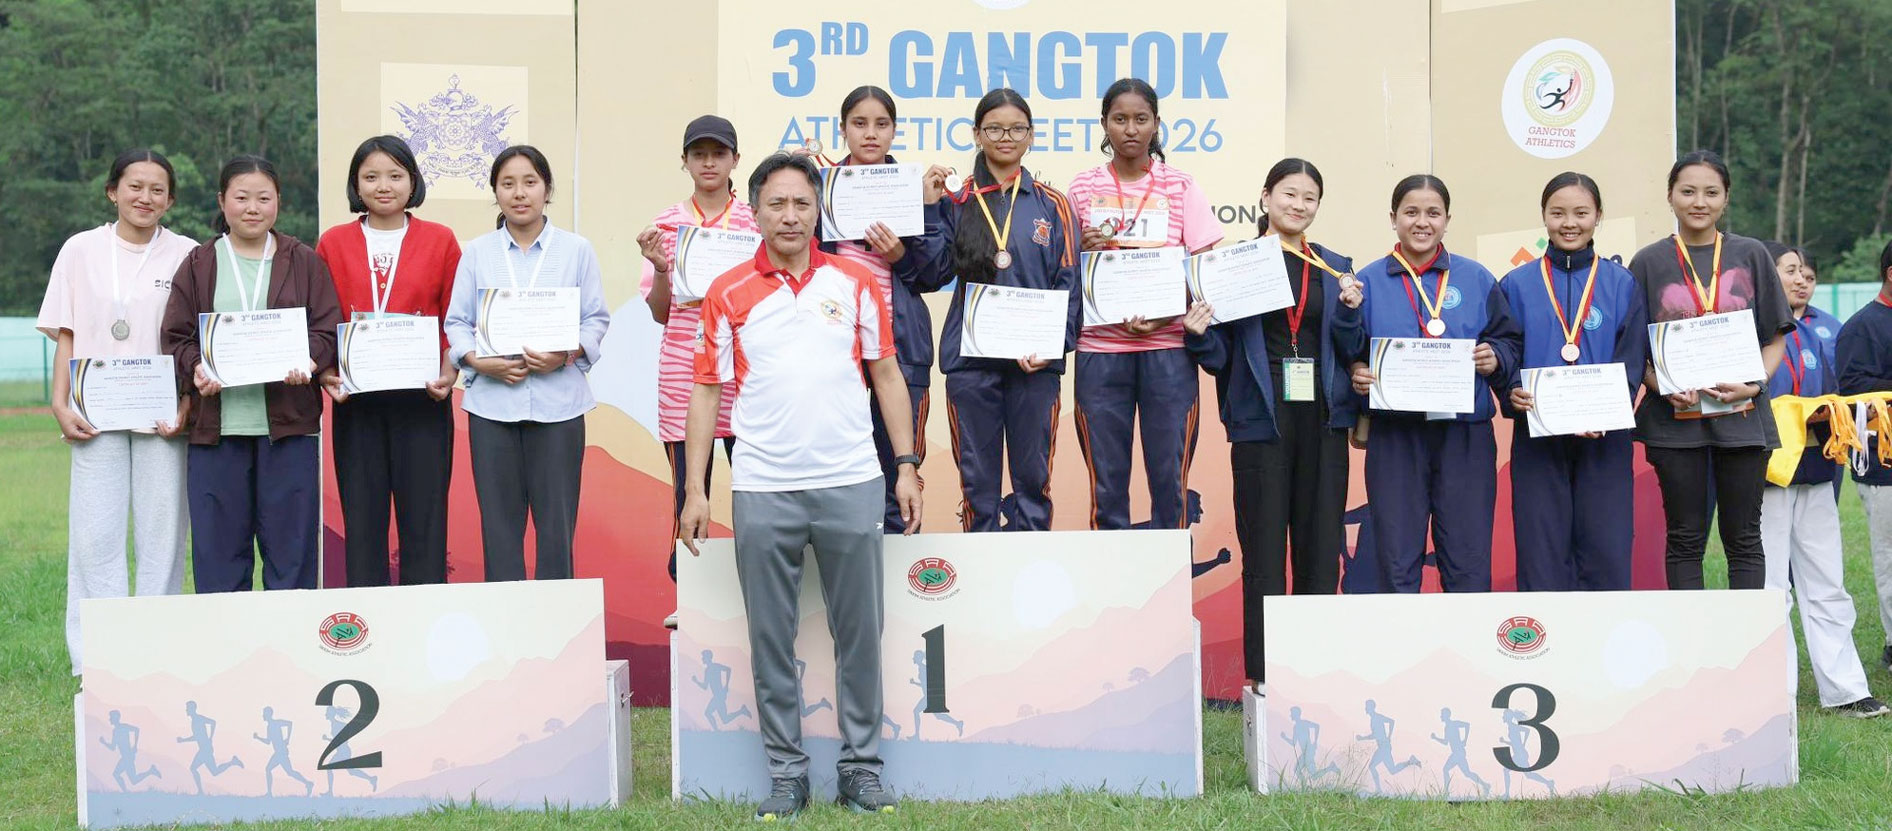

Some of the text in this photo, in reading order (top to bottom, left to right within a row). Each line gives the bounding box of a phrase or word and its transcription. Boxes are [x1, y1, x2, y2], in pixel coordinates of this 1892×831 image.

[772, 21, 1229, 100] 3RD GANGTOK
[1029, 118, 1100, 152] EET
[1528, 126, 1576, 137] GANGTOK
[1525, 137, 1576, 149] ATHLETICS
[870, 167, 899, 175] GANGTOK
[1131, 251, 1161, 260] GANGTOK
[1421, 341, 1452, 350] GANGTOK
[122, 358, 152, 366] GANGTOK
[921, 623, 950, 713] 1
[315, 679, 382, 770] 2
[1491, 683, 1560, 772] 3
